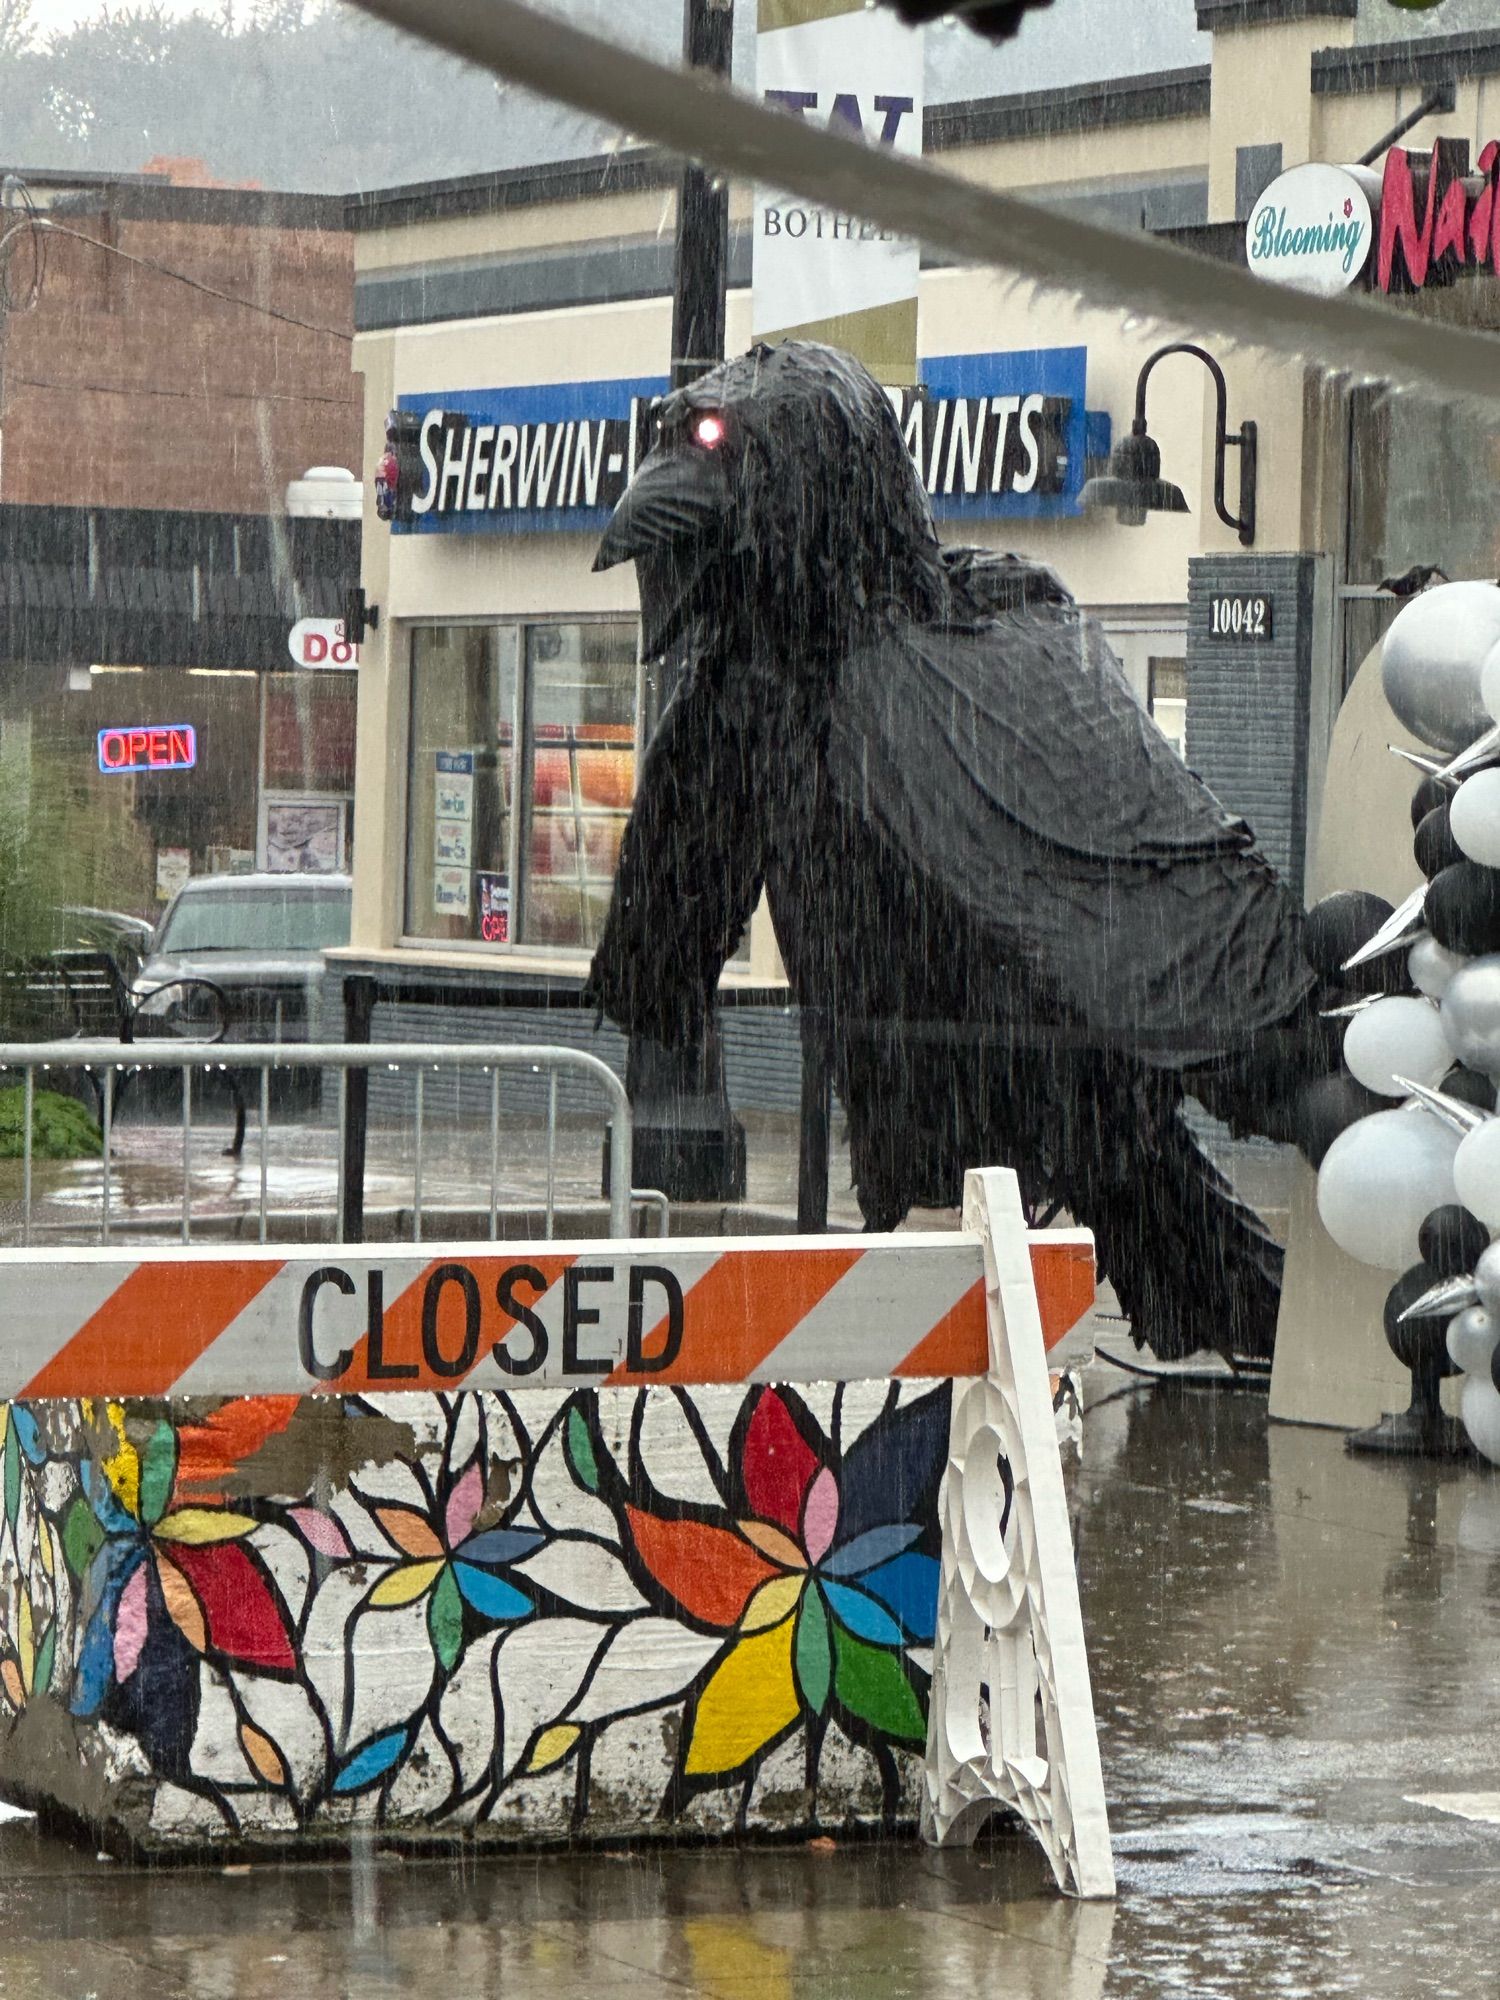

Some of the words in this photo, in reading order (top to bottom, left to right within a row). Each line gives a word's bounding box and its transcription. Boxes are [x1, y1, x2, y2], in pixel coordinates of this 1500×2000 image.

[1252, 206, 1365, 273] Blooming
[1212, 598, 1265, 634] 10042
[102, 729, 195, 768] OPEN
[299, 1263, 684, 1381] CLOSED
